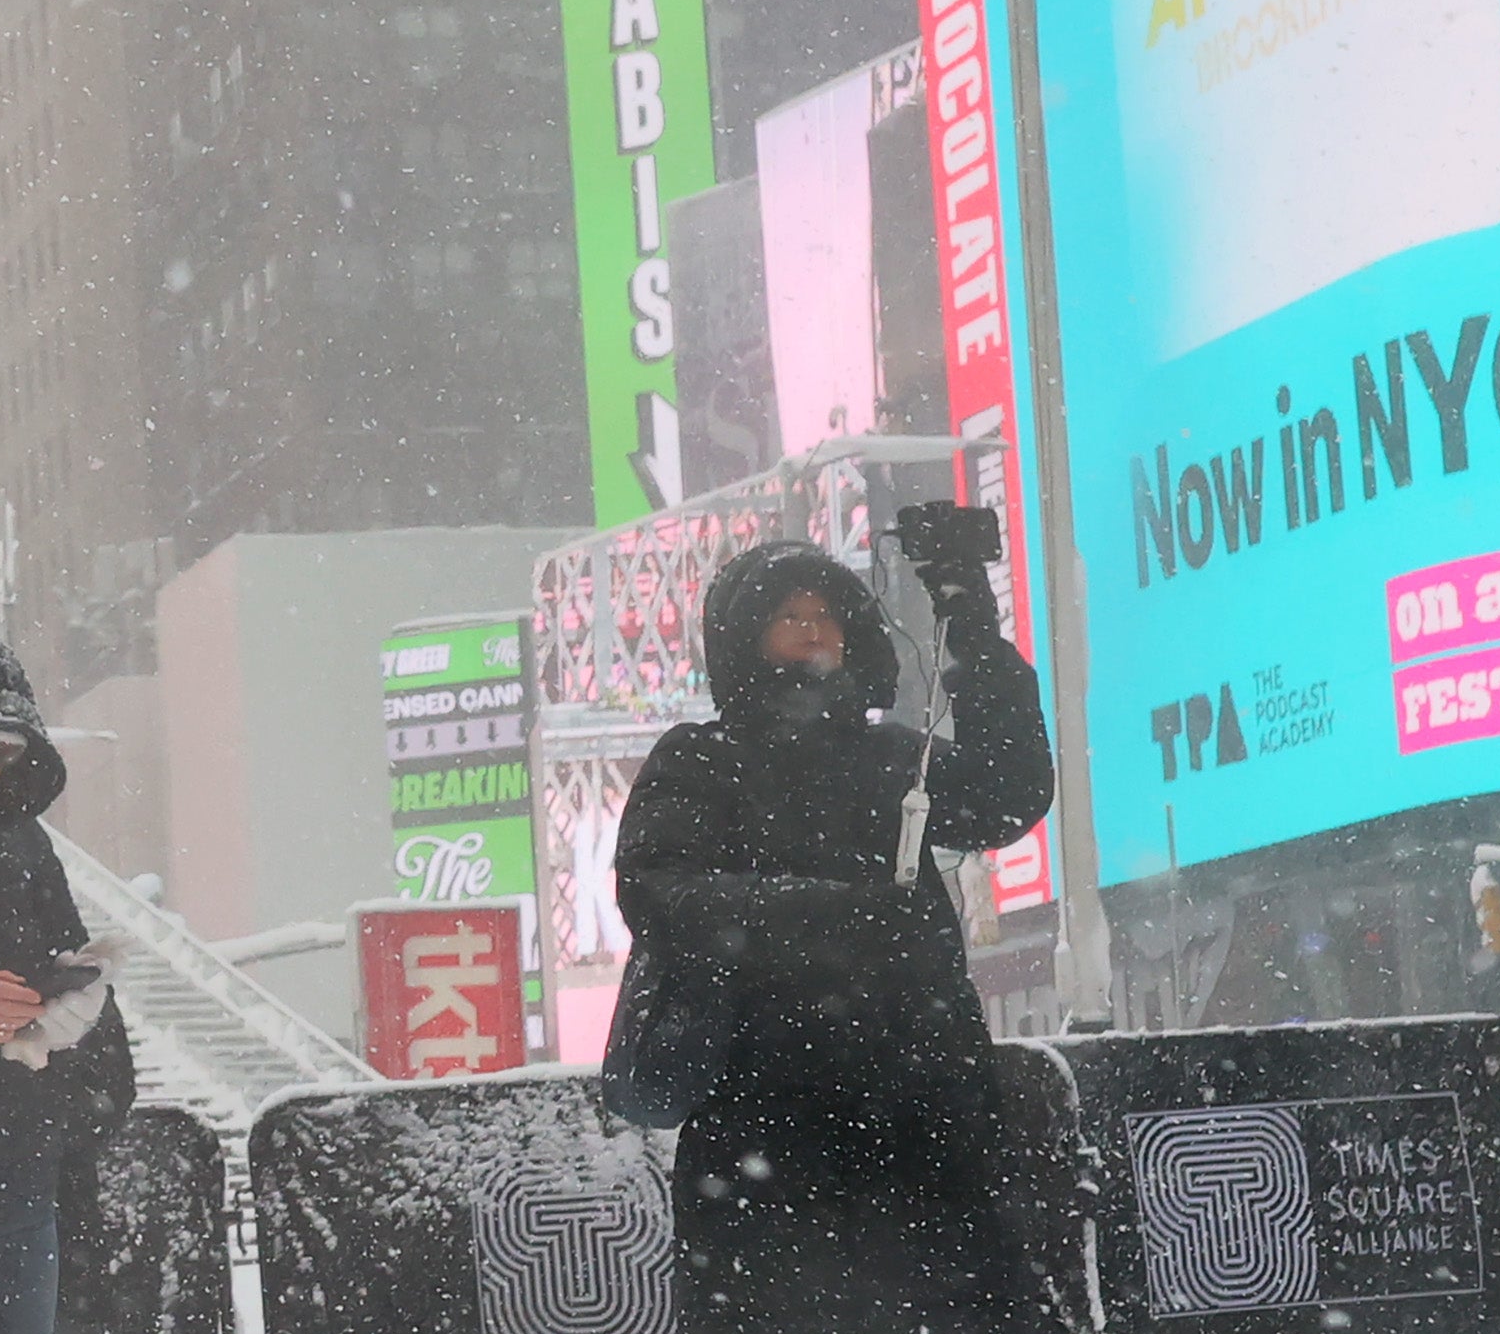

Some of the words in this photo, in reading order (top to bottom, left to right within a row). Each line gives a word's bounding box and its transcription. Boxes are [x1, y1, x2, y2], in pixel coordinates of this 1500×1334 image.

[1131, 434, 1265, 590] Now
[1275, 382, 1346, 534] in
[1395, 579, 1463, 644] on
[1252, 664, 1284, 696] THE
[1254, 679, 1328, 728] PODCAST
[1258, 707, 1336, 758] ACADEMY
[394, 830, 494, 904] The
[402, 922, 499, 1078] tkt
[1330, 1136, 1442, 1180] TIMES
[1327, 1178, 1457, 1221] SQUARE
[1341, 1225, 1454, 1259] ALLIANCE
